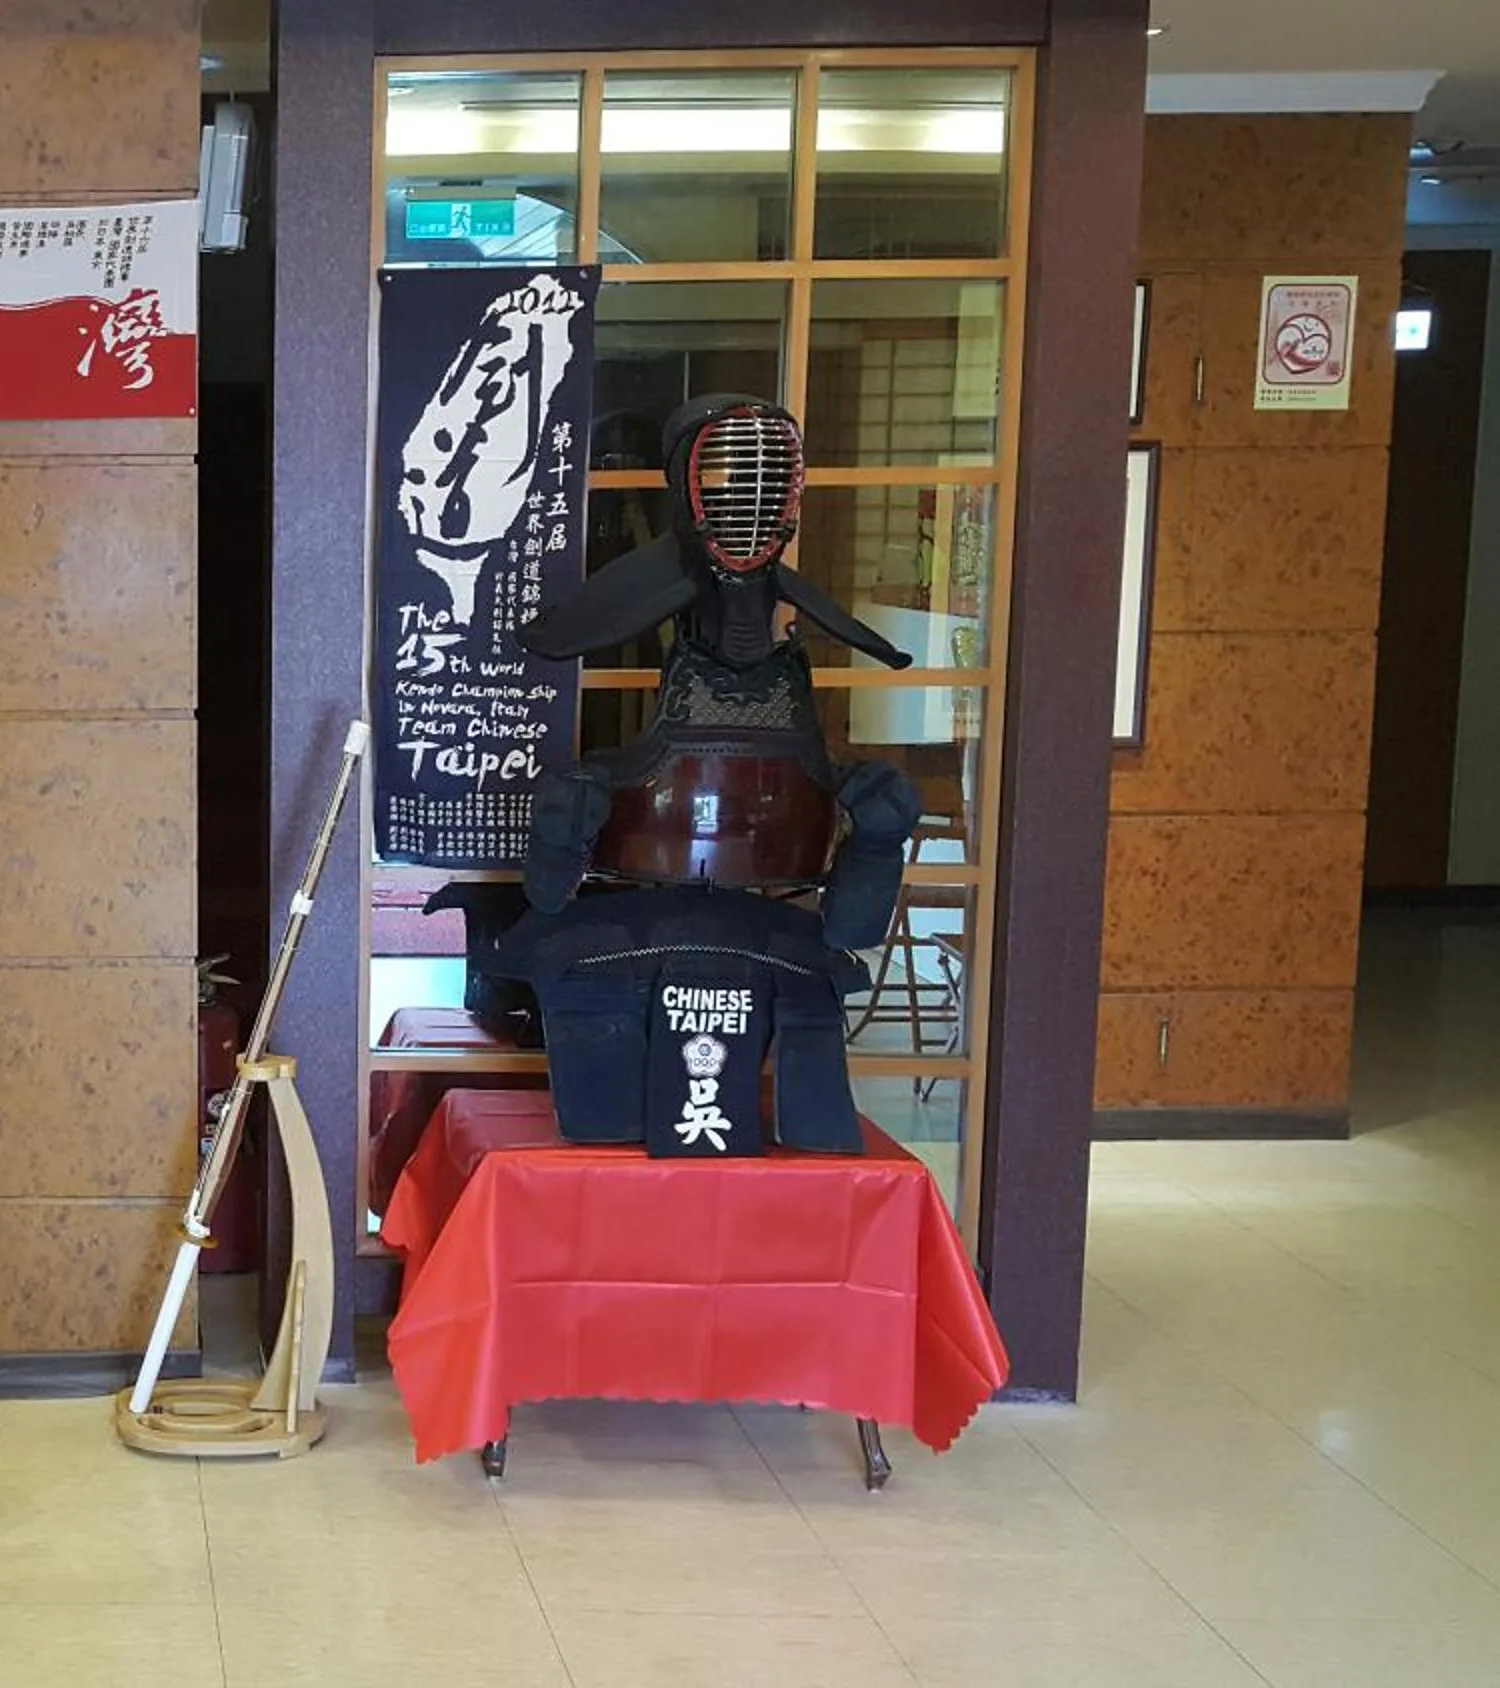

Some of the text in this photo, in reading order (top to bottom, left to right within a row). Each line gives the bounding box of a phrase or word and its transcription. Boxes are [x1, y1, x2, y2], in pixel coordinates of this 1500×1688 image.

[546, 421, 574, 552] 第十五屆
[398, 602, 451, 636] The
[479, 661, 525, 677] World
[395, 680, 444, 697] Kendo
[491, 700, 530, 720] Italy
[398, 717, 549, 740] Team Chinese
[396, 737, 545, 792] Taipei
[662, 985, 753, 1012] CHINESE
[666, 1009, 748, 1035] TAIPEI
